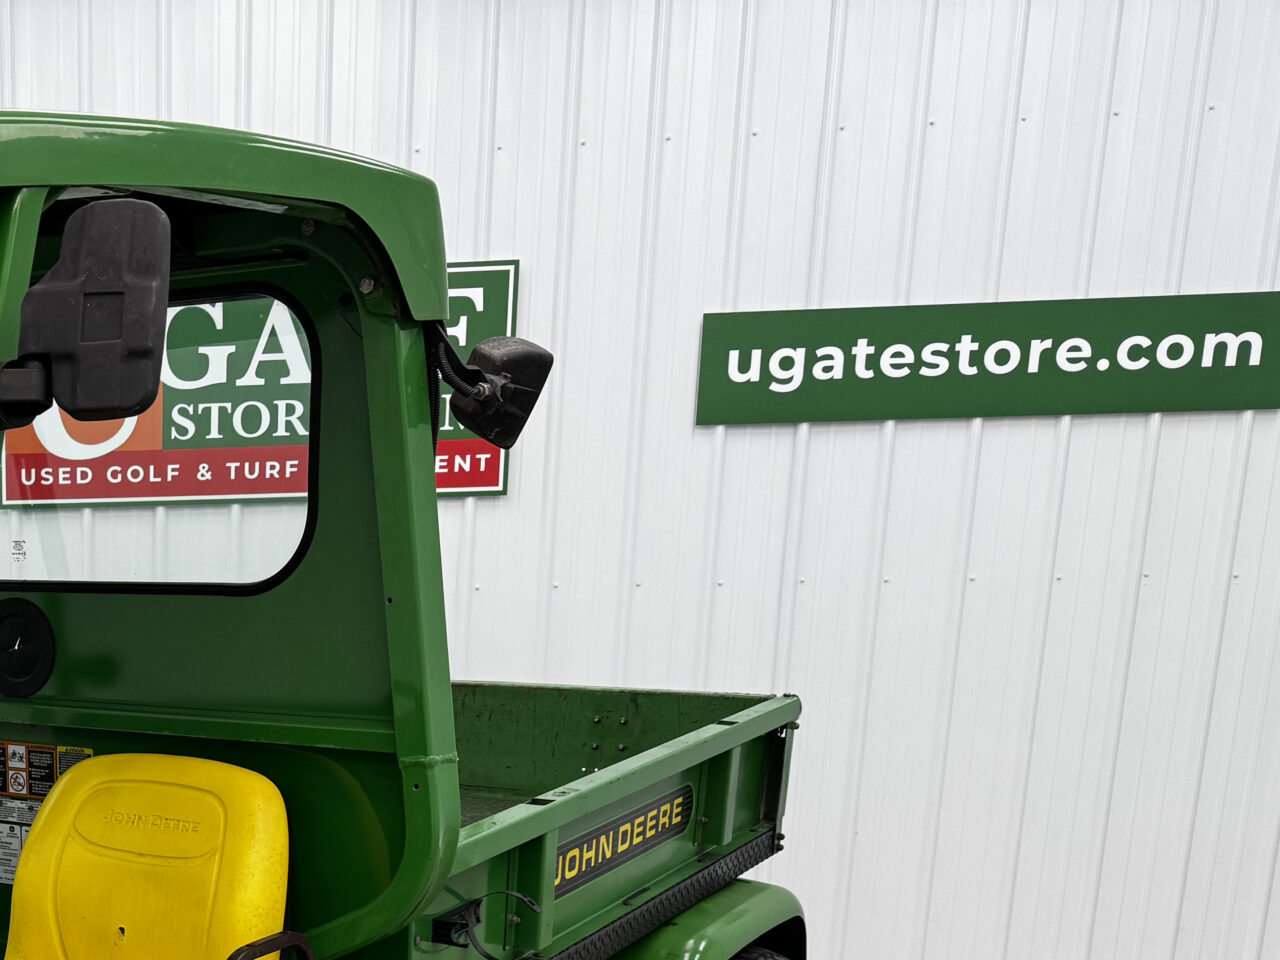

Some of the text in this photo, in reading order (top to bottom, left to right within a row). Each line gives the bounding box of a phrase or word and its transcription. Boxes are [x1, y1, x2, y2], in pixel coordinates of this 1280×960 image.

[726, 331, 1264, 393] ugatestore.com
[170, 400, 310, 440] STOR
[20, 460, 300, 486] USED GOLF & TURF
[554, 796, 684, 886] JOHN DEERE
